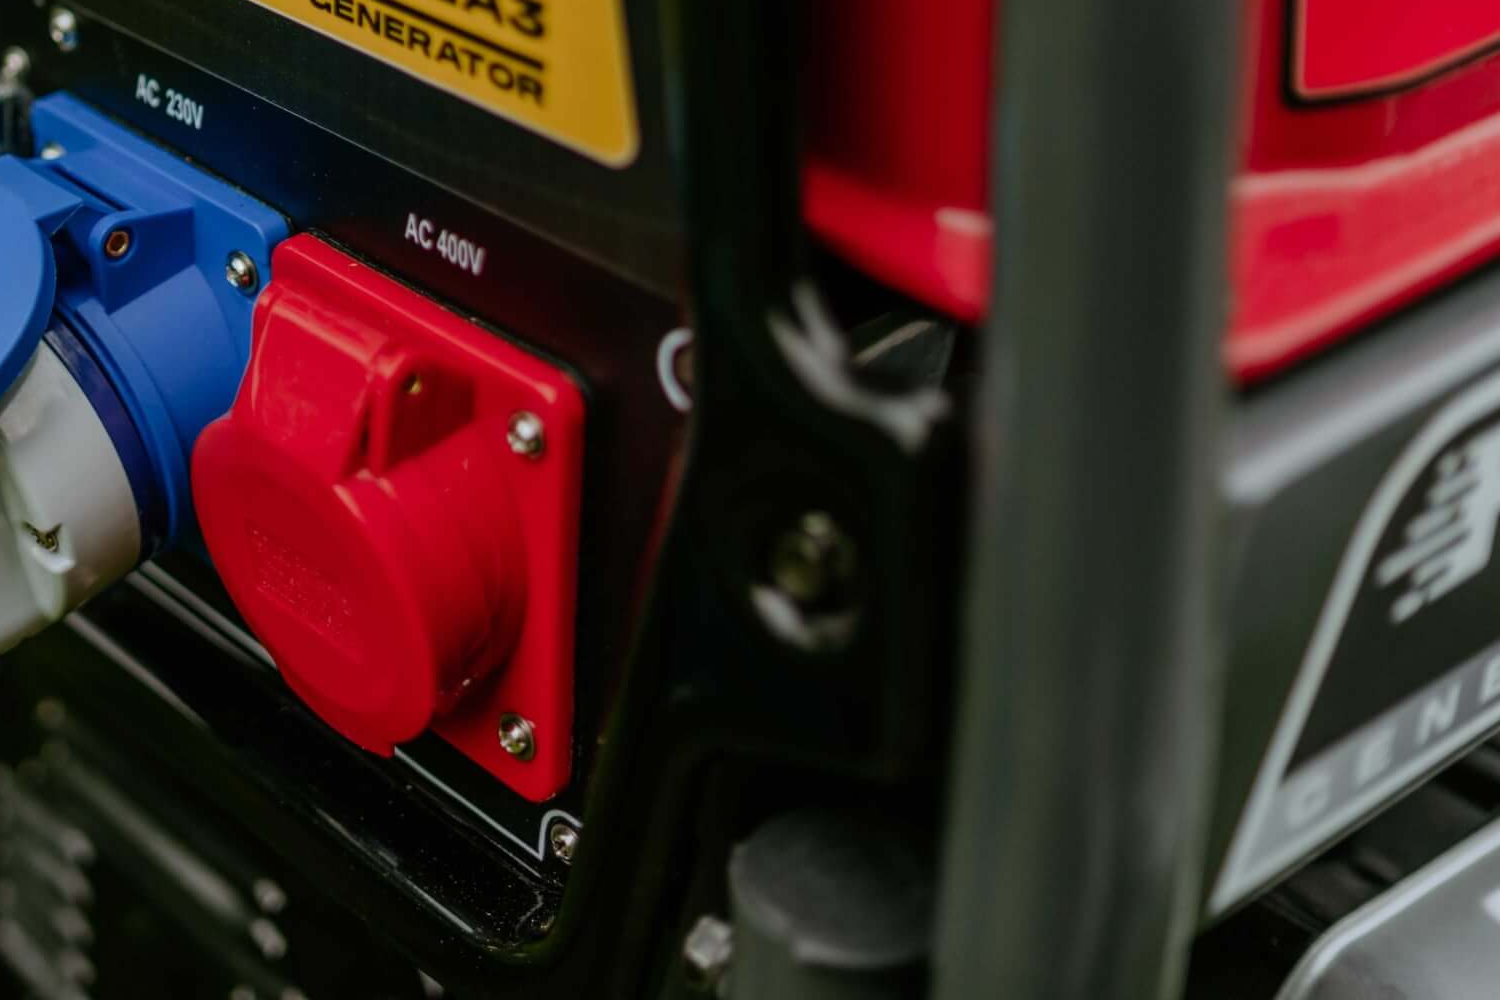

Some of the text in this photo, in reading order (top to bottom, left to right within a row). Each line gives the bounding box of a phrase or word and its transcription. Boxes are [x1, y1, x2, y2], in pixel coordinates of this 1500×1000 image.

[135, 73, 204, 131] AC 230V
[404, 212, 486, 277] AC 400V
